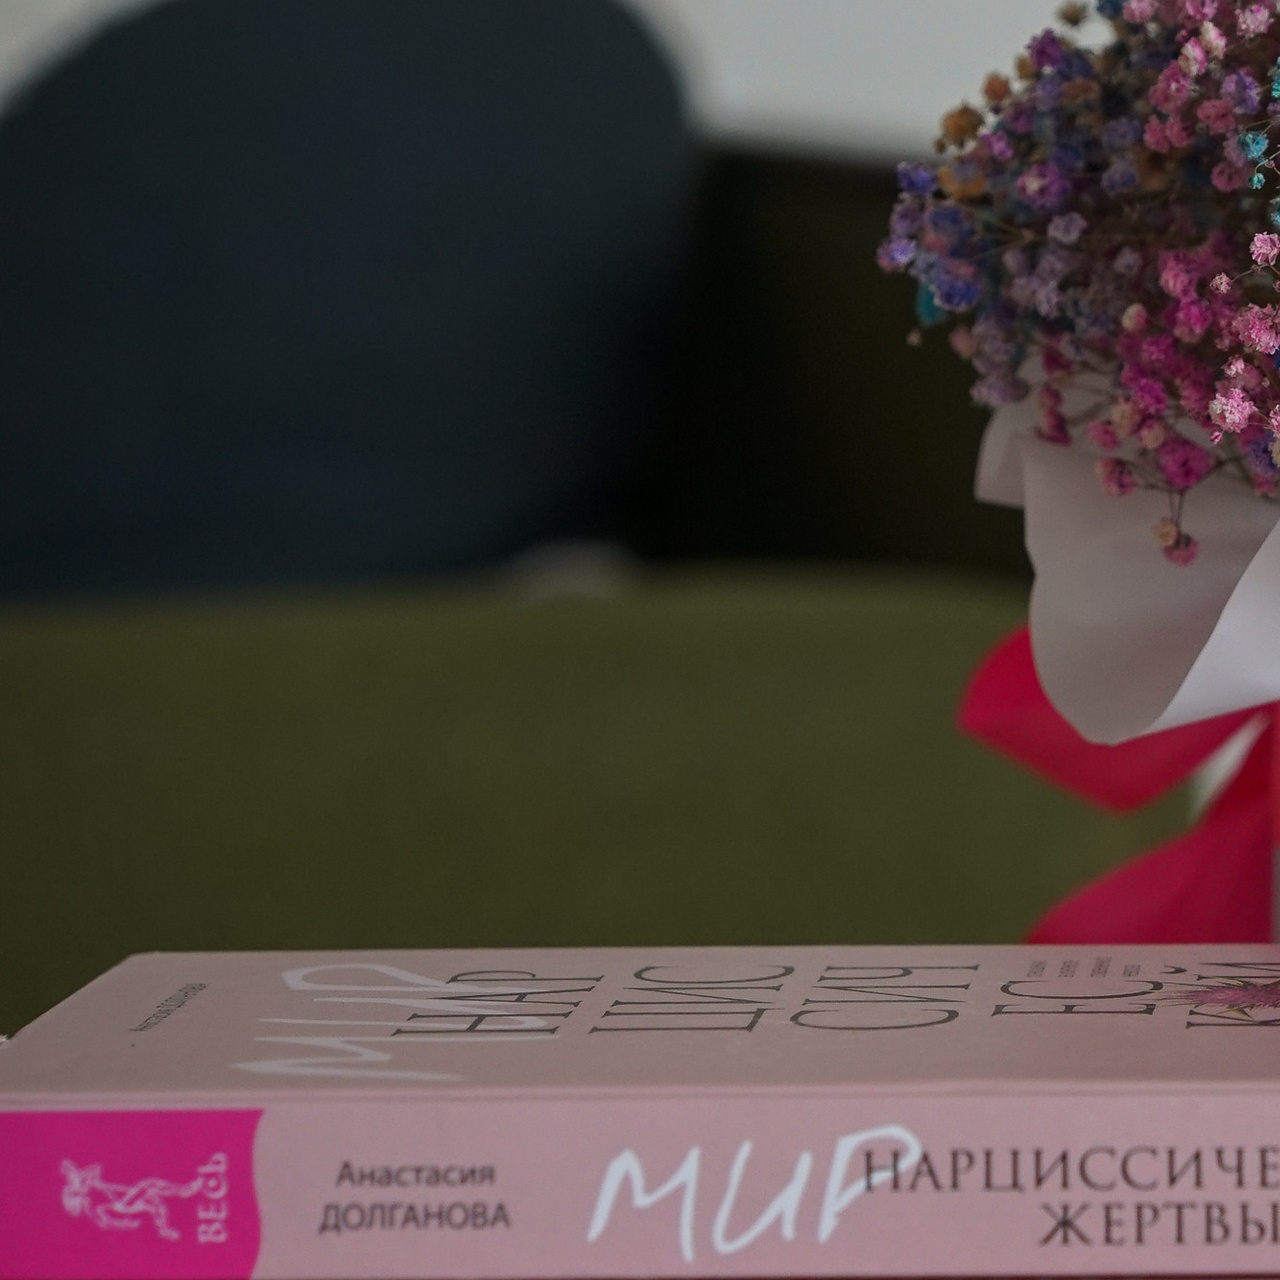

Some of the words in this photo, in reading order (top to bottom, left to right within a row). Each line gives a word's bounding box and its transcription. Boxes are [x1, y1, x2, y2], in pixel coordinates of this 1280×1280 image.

[392, 970, 604, 1036] НАР
[590, 964, 795, 1034] ЦИС
[790, 963, 980, 1031] СИЧ
[991, 980, 1165, 1018] ЕС
[197, 1151, 228, 1245] ВЕСЬ
[335, 1160, 496, 1189] Анастасия
[319, 1201, 511, 1234] ДОЛГАНОВА
